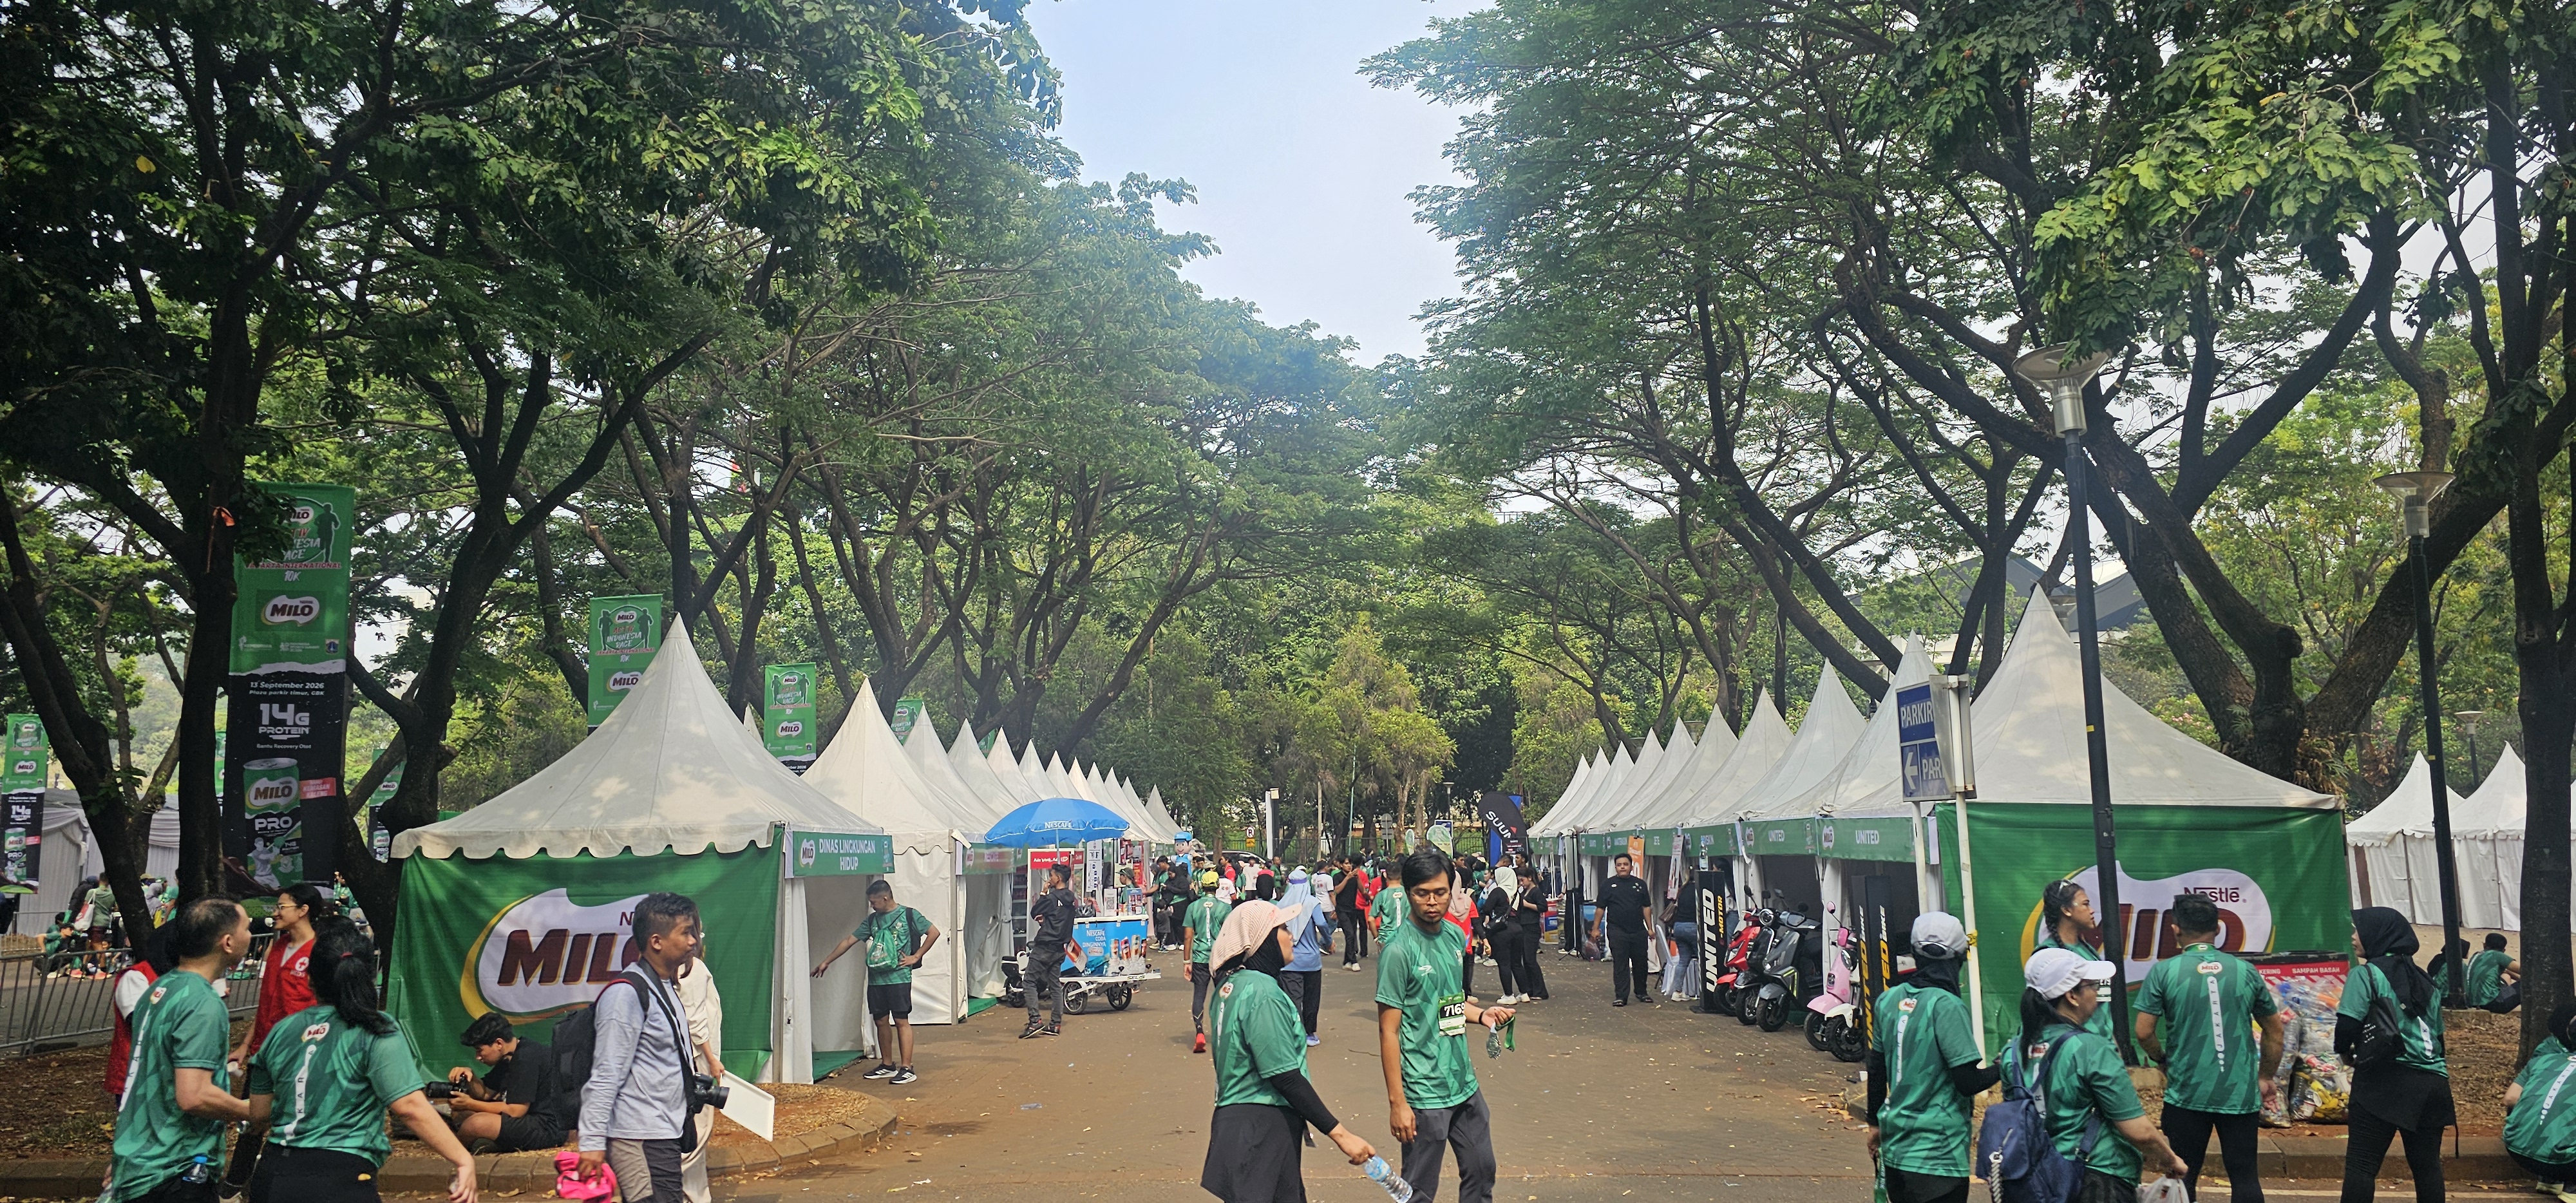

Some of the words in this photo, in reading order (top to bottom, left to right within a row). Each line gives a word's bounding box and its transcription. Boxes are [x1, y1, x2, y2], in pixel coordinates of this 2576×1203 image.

[284, 571, 301, 582] 10K
[270, 604, 314, 616] MILO
[607, 632, 642, 643] INDONESIA
[616, 639, 632, 649] RACE
[620, 654, 630, 663] 10K
[612, 677, 639, 687] MILO
[260, 703, 310, 725] 14G
[1900, 701, 1934, 728] PARKIR
[1922, 757, 1944, 780] PAR
[254, 785, 293, 800] MILO
[254, 816, 292, 831] PRO
[1768, 829, 1785, 842] UNITED
[1855, 829, 1879, 844] UNITED
[819, 838, 838, 853] DINAS
[839, 839, 876, 853] LINGKUNGAN
[802, 847, 814, 860] MILO
[840, 856, 858, 871] HIDUP
[2184, 887, 2240, 903] stlé
[1702, 888, 1718, 993] UNITED
[497, 928, 641, 987] MIL
[2210, 980, 2223, 1048] JAKARTA
[2544, 1064, 2575, 1107] JAKARTA
